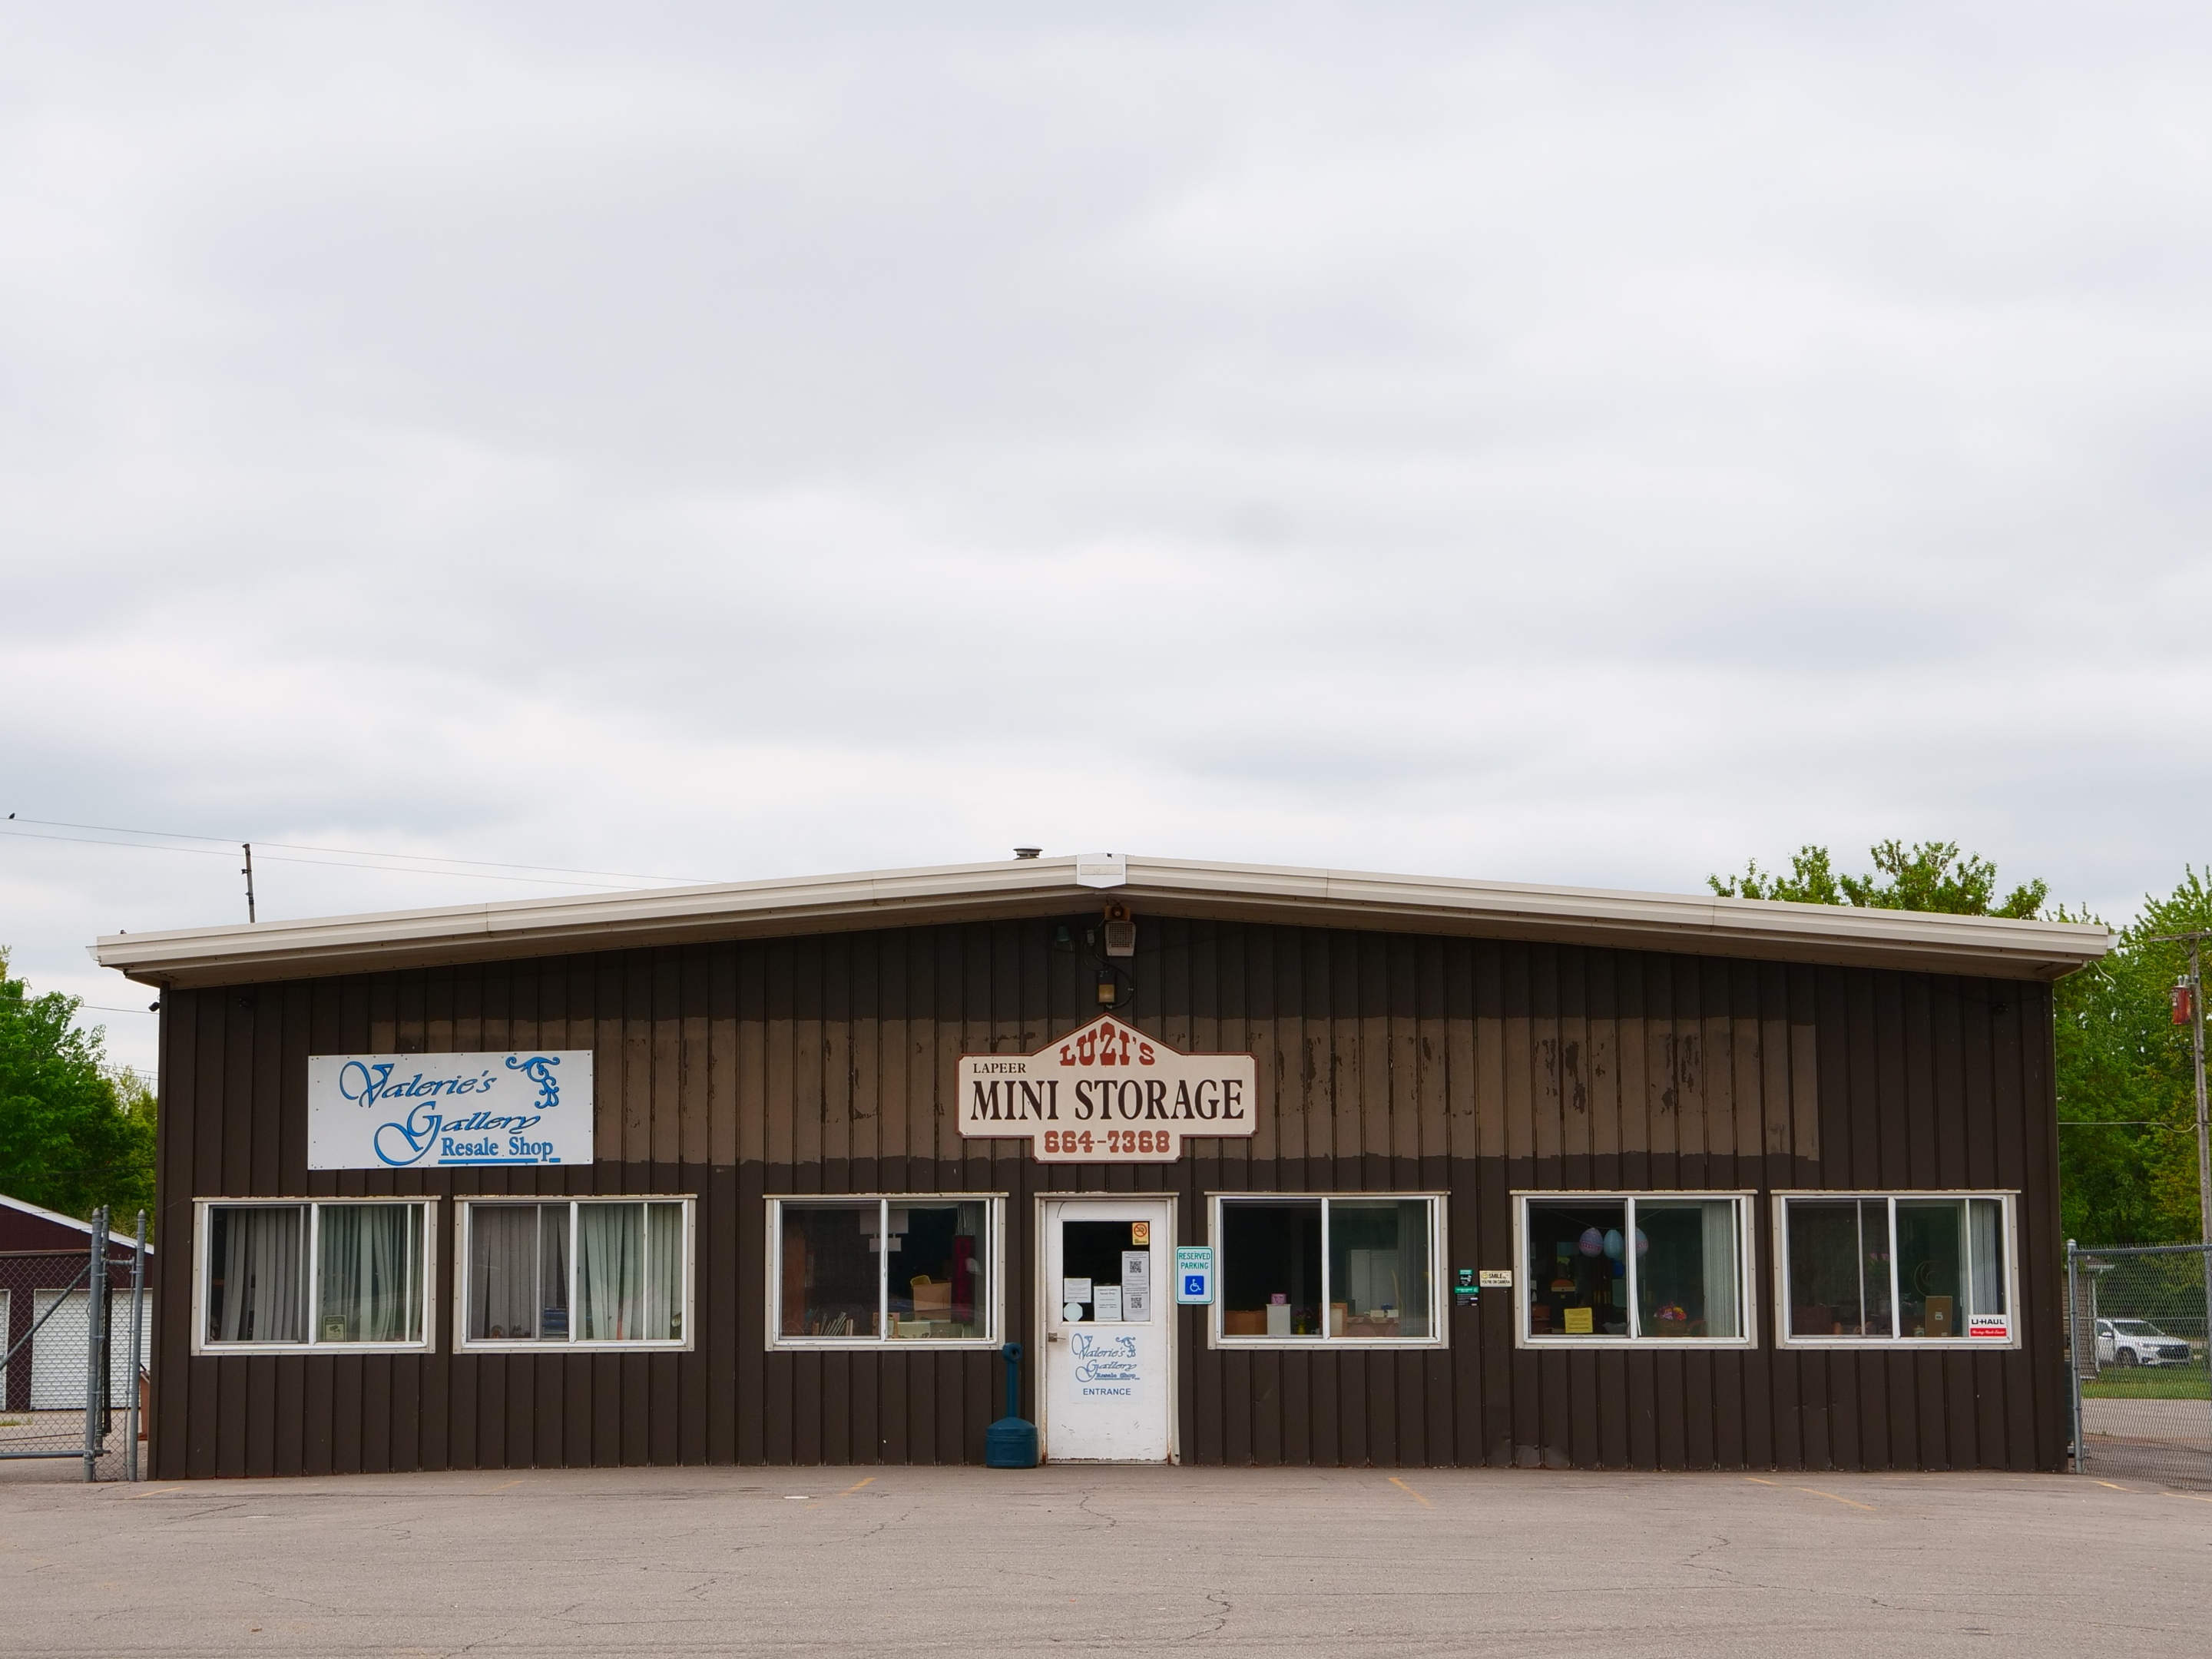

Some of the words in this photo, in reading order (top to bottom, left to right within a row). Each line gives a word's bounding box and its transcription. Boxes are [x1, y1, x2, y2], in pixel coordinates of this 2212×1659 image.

[1059, 1022, 1155, 1067] LUZI'S
[972, 1062, 1027, 1074] LAPEER
[339, 1061, 498, 1108] Valerie's
[970, 1080, 1059, 1121] MINI
[1075, 1078, 1244, 1120] STORAGE
[374, 1101, 541, 1166] Gallery
[1044, 1130, 1171, 1153] 664-7368
[441, 1137, 499, 1157] Resale
[508, 1137, 554, 1161] Shop
[1178, 1252, 1210, 1260] RESERVED
[1071, 1333, 1126, 1360] Valerie's
[1075, 1359, 1137, 1382] Gallery
